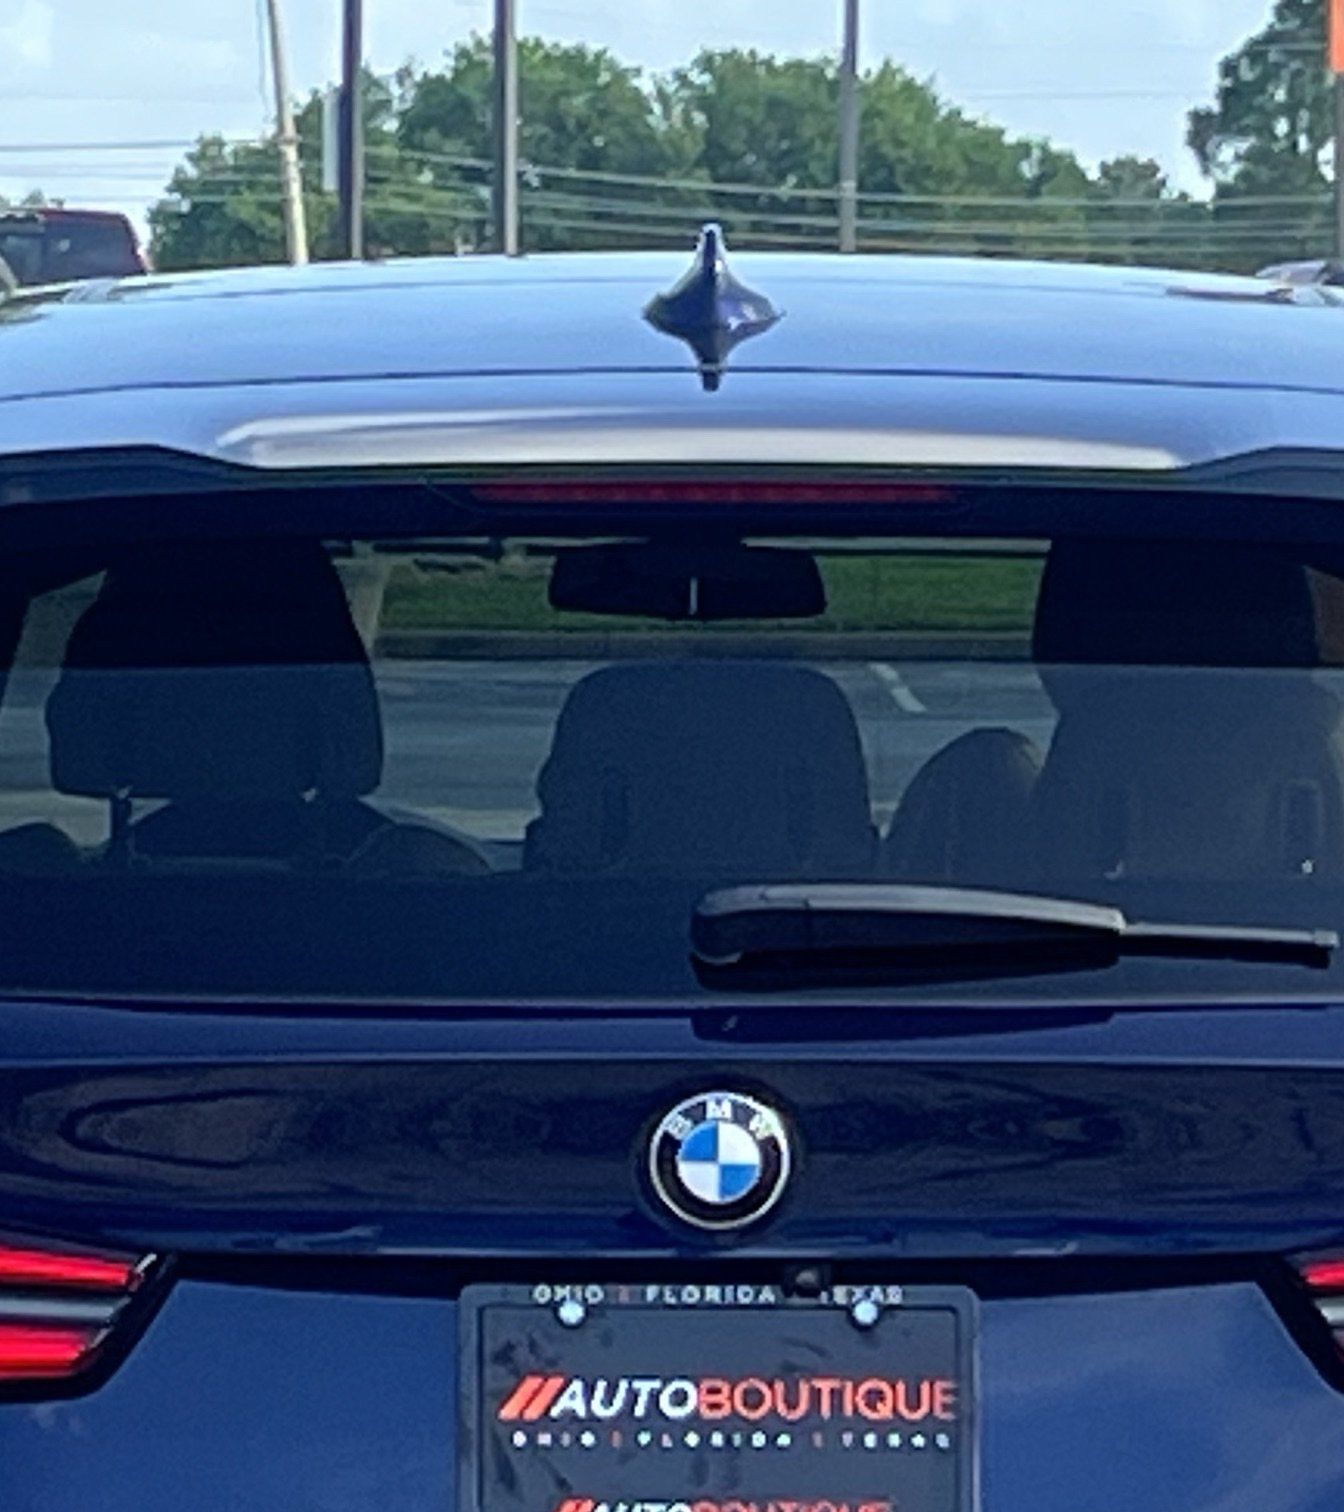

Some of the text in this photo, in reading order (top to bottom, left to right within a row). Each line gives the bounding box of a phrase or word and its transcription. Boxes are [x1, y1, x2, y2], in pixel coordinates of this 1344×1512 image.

[660, 1098, 779, 1141] BMW
[645, 1284, 776, 1305] FLORIDA
[818, 1284, 904, 1305] EXAS
